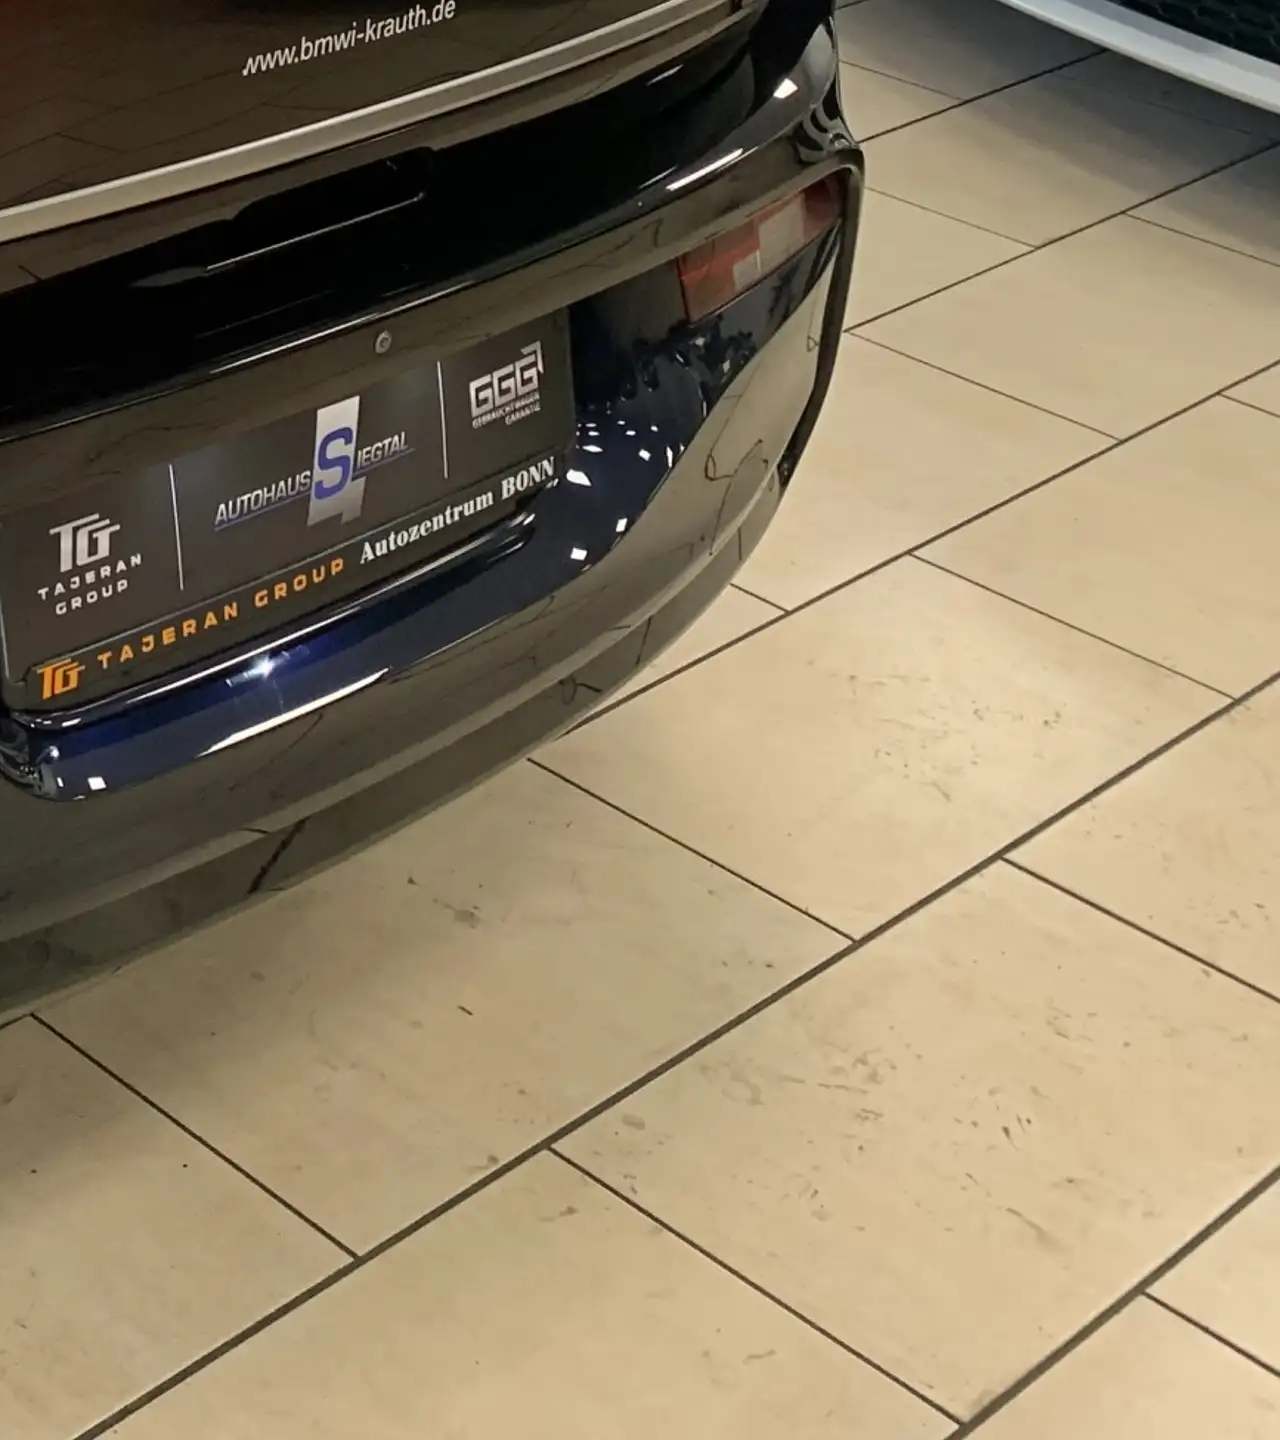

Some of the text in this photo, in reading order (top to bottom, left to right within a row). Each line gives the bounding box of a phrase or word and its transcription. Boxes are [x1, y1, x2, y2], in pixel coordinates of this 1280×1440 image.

[214, 470, 311, 526] AUTOHAUS
[360, 456, 555, 564] Autozentrum BONN
[37, 553, 142, 601] TAJERAN
[55, 579, 129, 616] GROUP
[97, 602, 239, 669] TAJERAN
[254, 558, 345, 608] GROUP
